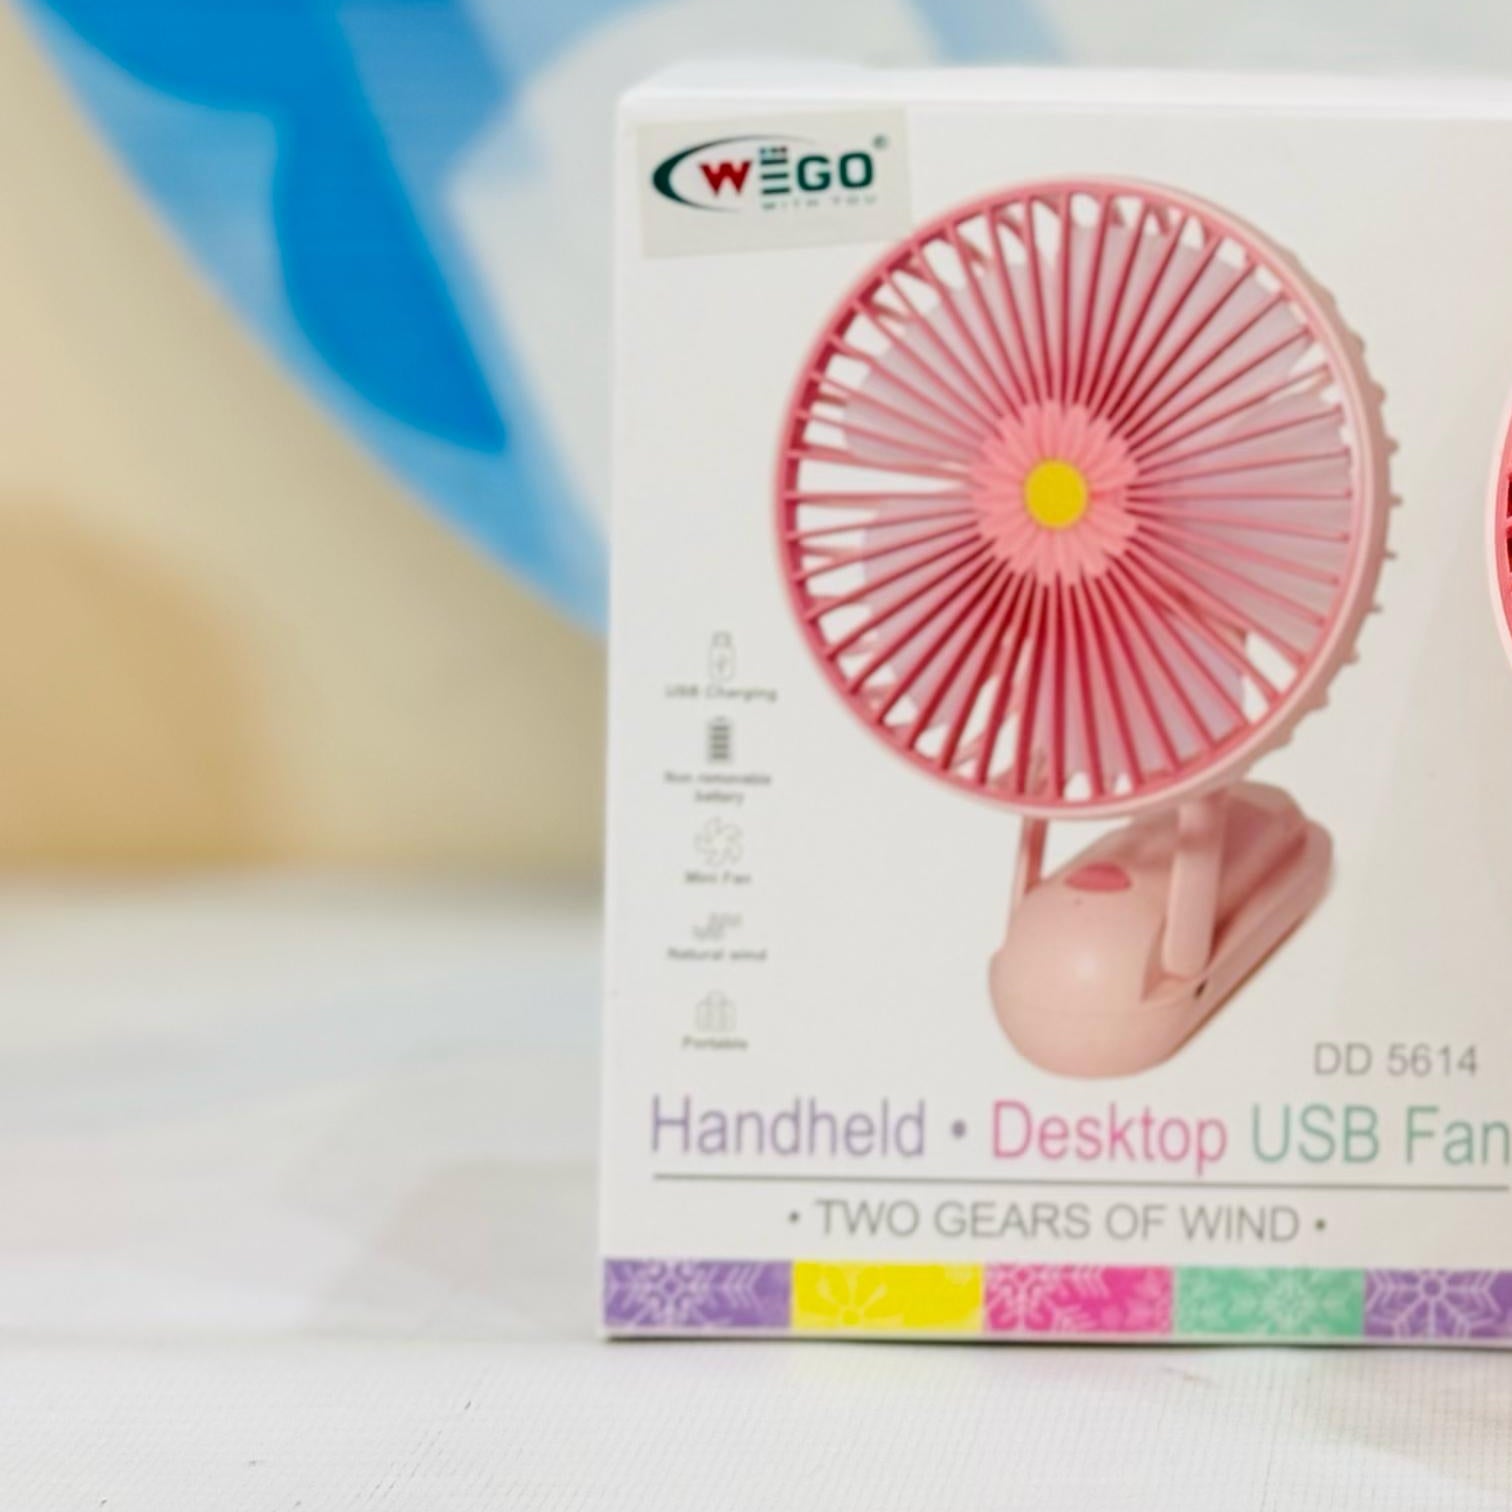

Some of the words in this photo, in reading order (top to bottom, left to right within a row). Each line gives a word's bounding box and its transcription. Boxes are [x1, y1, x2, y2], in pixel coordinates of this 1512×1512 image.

[698, 145, 875, 197] WEGO
[1313, 1041, 1374, 1077] DD
[1386, 1043, 1480, 1078] 5614
[650, 1093, 927, 1159] Handheld
[991, 1098, 1229, 1177] Desktop
[1251, 1102, 1381, 1166] USB
[1405, 1103, 1512, 1167] Fan
[815, 1198, 921, 1238] TWO
[933, 1200, 1092, 1242] GEARS
[1105, 1202, 1168, 1241] OF
[1179, 1204, 1301, 1244] WIND
